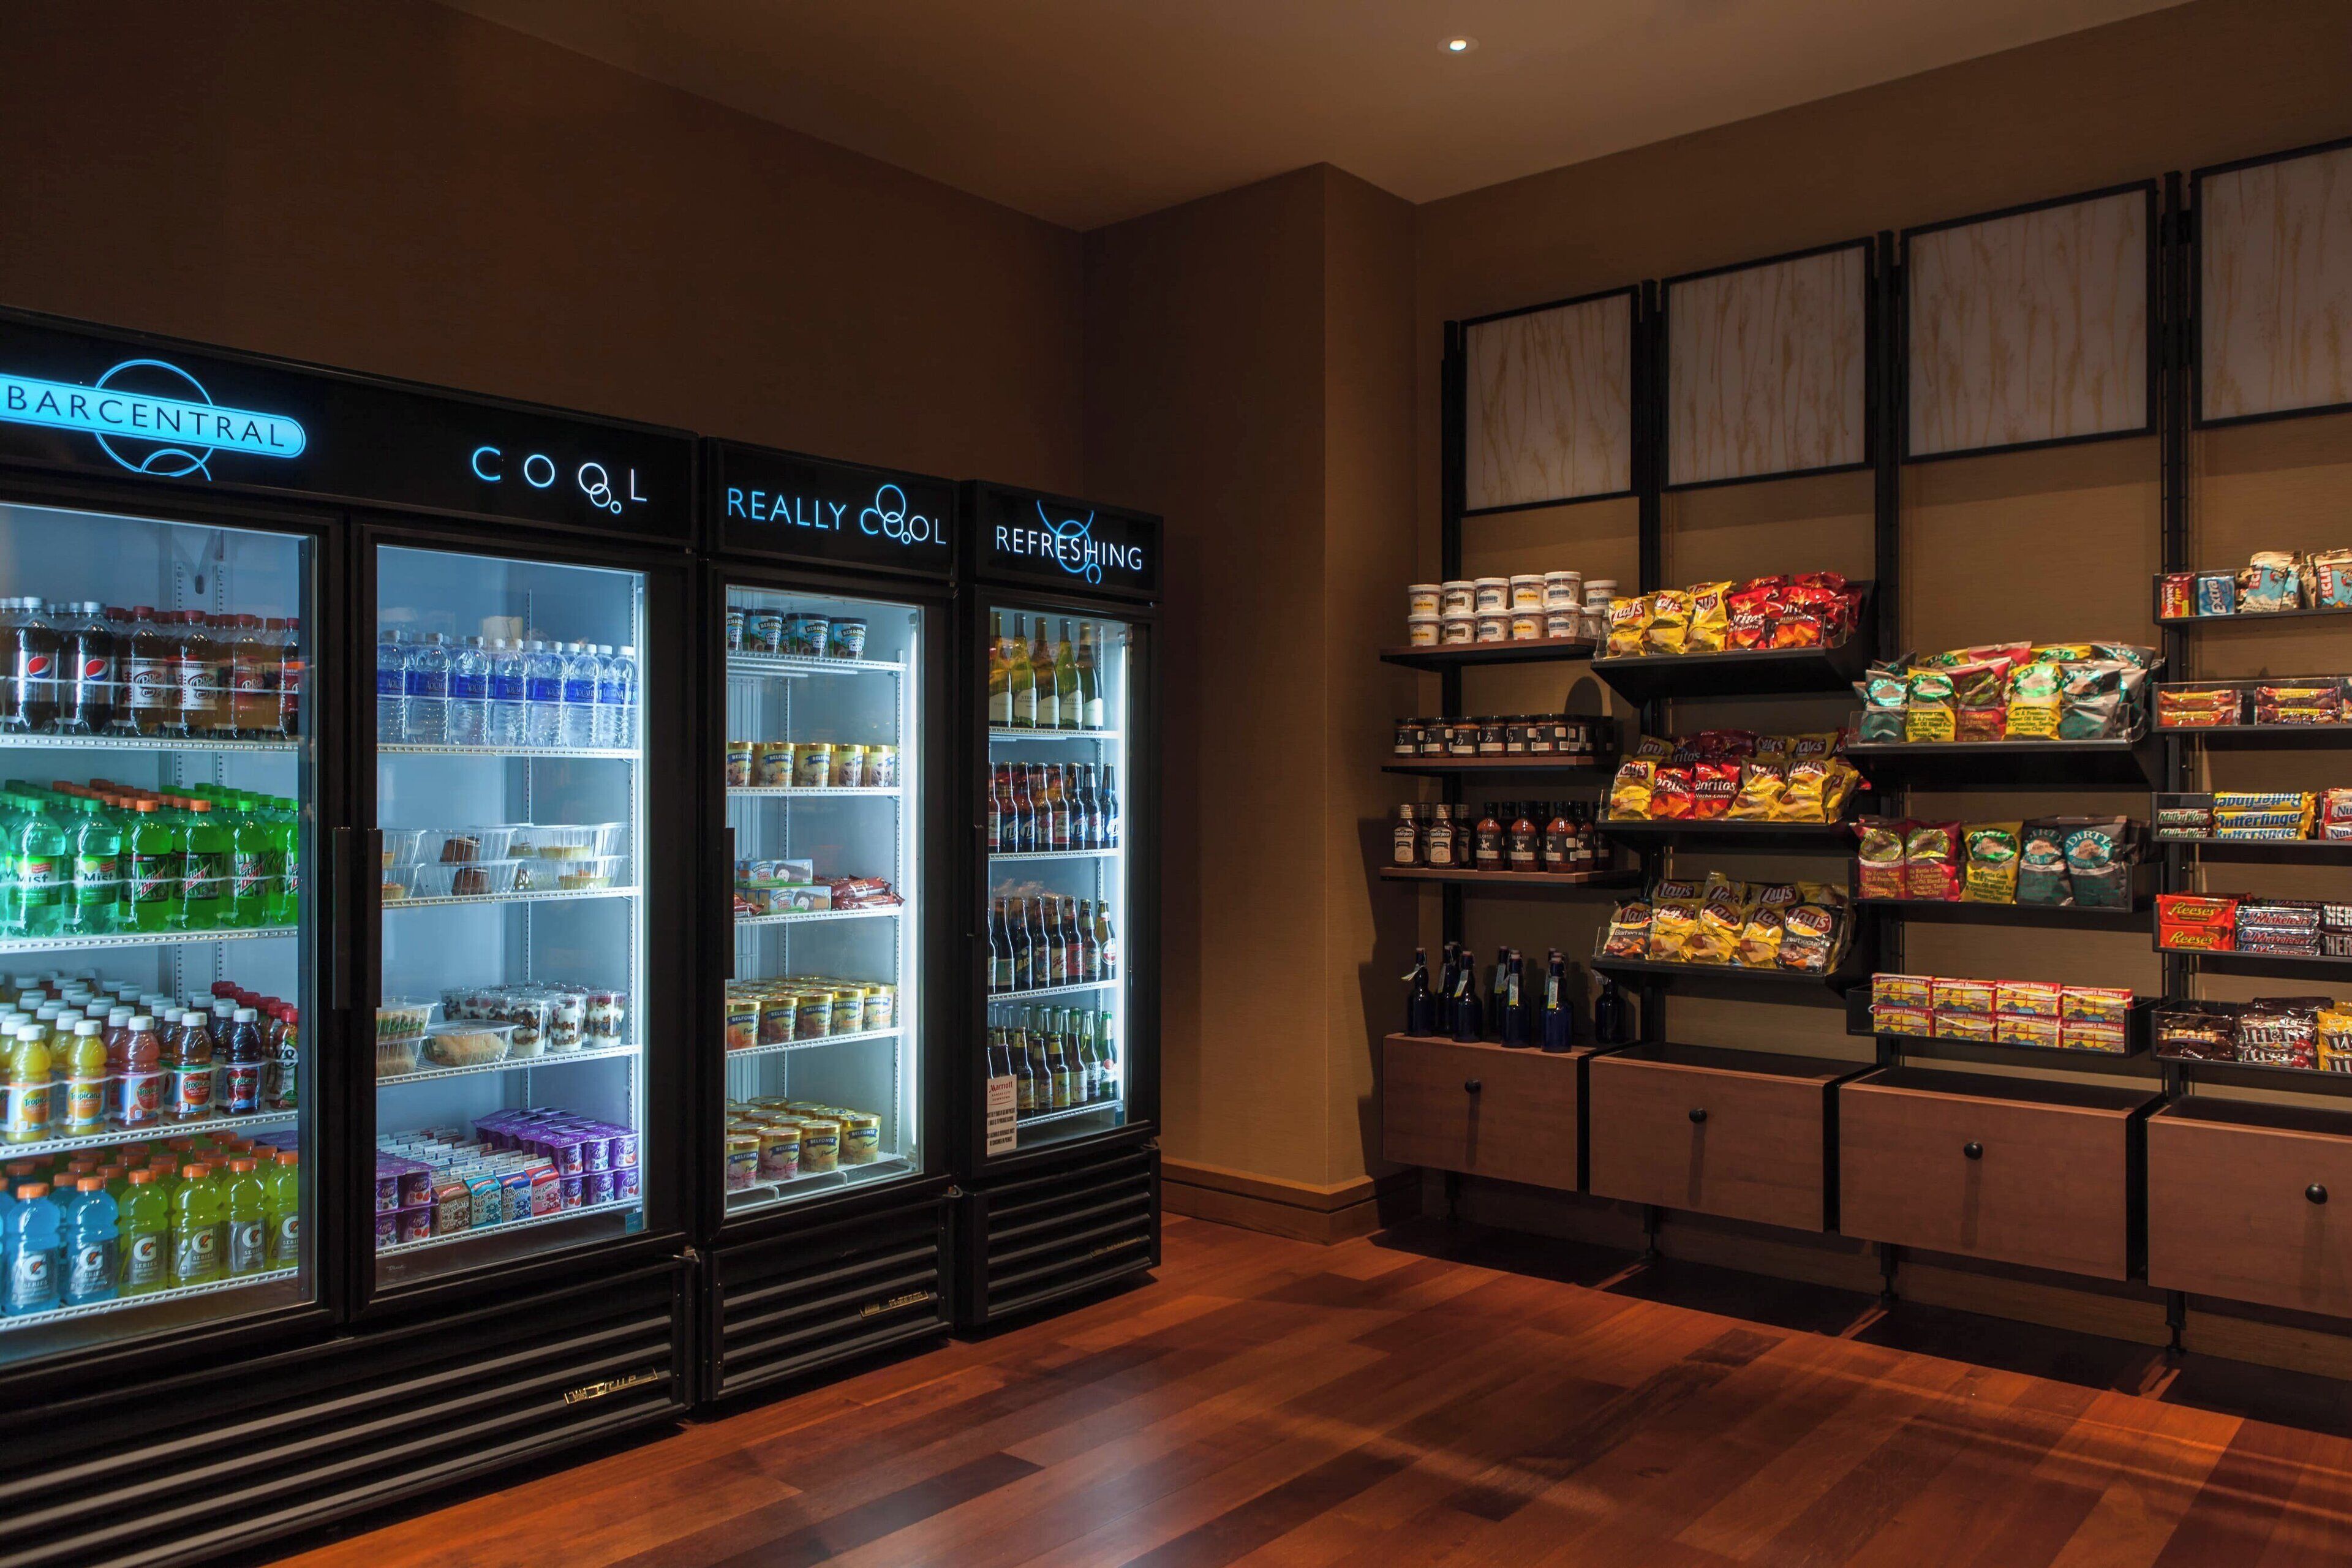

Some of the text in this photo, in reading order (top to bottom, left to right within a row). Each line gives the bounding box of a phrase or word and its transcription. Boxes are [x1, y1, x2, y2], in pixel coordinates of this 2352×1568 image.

[7, 385, 285, 448] BARCENTRAL
[727, 487, 947, 545] REALLY COOL
[996, 525, 1143, 570] REFRESHING
[2217, 813, 2304, 827] Butterfinger
[2171, 902, 2215, 917] Reese's
[2255, 912, 2311, 925] Musketeers
[2169, 930, 2214, 945] Reese's
[2253, 930, 2309, 945] Musketeers
[989, 1080, 1013, 1094] Marriott
